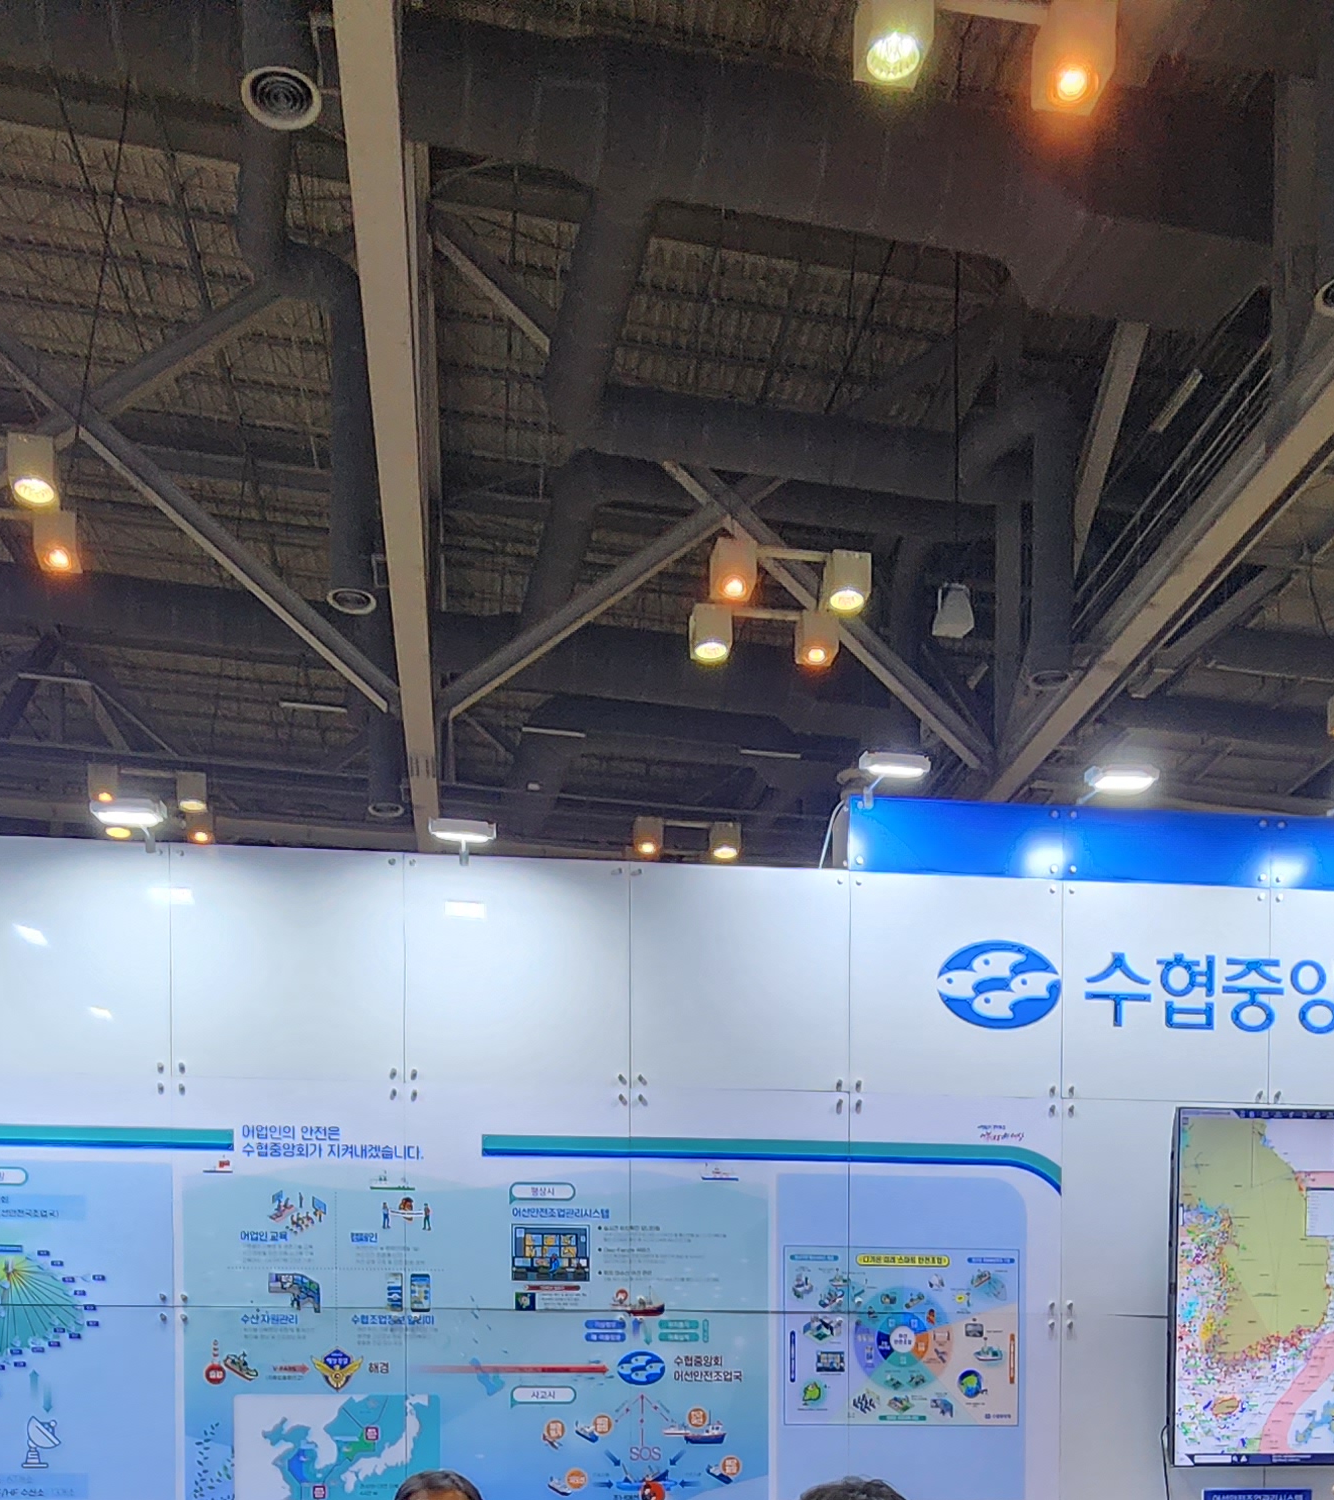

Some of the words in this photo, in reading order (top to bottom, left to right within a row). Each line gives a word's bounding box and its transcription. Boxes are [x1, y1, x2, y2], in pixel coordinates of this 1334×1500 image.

[242, 1124, 295, 1141] 어업인의
[300, 1125, 341, 1142] 안전은
[242, 1142, 323, 1158] 수협중앙회가
[327, 1144, 424, 1160] 지켜내겠습니다.
[512, 1207, 610, 1219] 어선안전조업관리시스템
[673, 1355, 723, 1367] 수협중앙회
[368, 1361, 389, 1374] 해경
[673, 1371, 743, 1383] 어선안전조업국
[531, 1390, 556, 1400] 사고시
[630, 1446, 661, 1461] SOS
